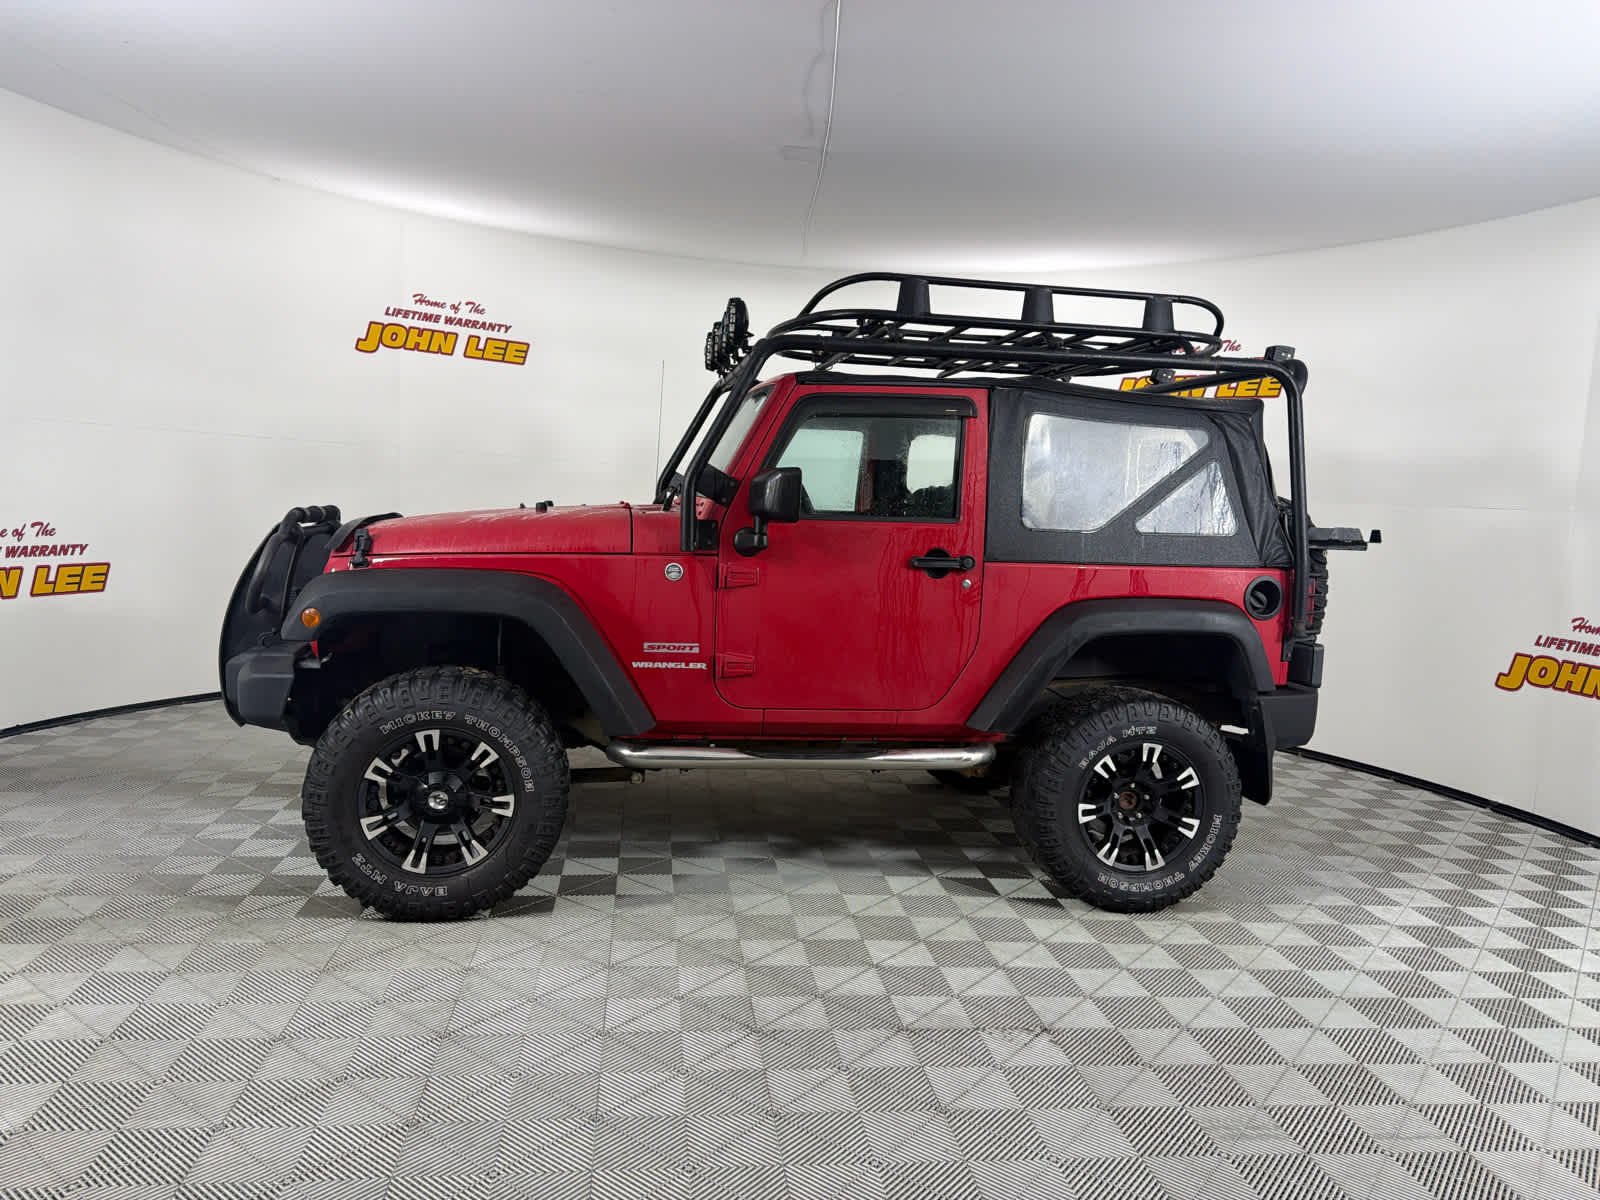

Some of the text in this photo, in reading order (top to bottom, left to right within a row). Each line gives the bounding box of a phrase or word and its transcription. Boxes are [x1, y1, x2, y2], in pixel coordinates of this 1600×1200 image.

[412, 293, 486, 315] Home of The
[384, 306, 512, 334] LIFETIME WARRANTY
[355, 321, 530, 366] JOHN LEE
[1223, 339, 1241, 352] The
[12, 523, 26, 542] of
[30, 521, 56, 537] The
[5, 543, 88, 559] WARRANTY
[30, 562, 111, 597] LEE
[1571, 617, 1600, 635] Hom
[643, 643, 699, 653] SPORT
[632, 661, 707, 670] WRANGLER
[380, 711, 535, 792] MICKEY THOMPSON
